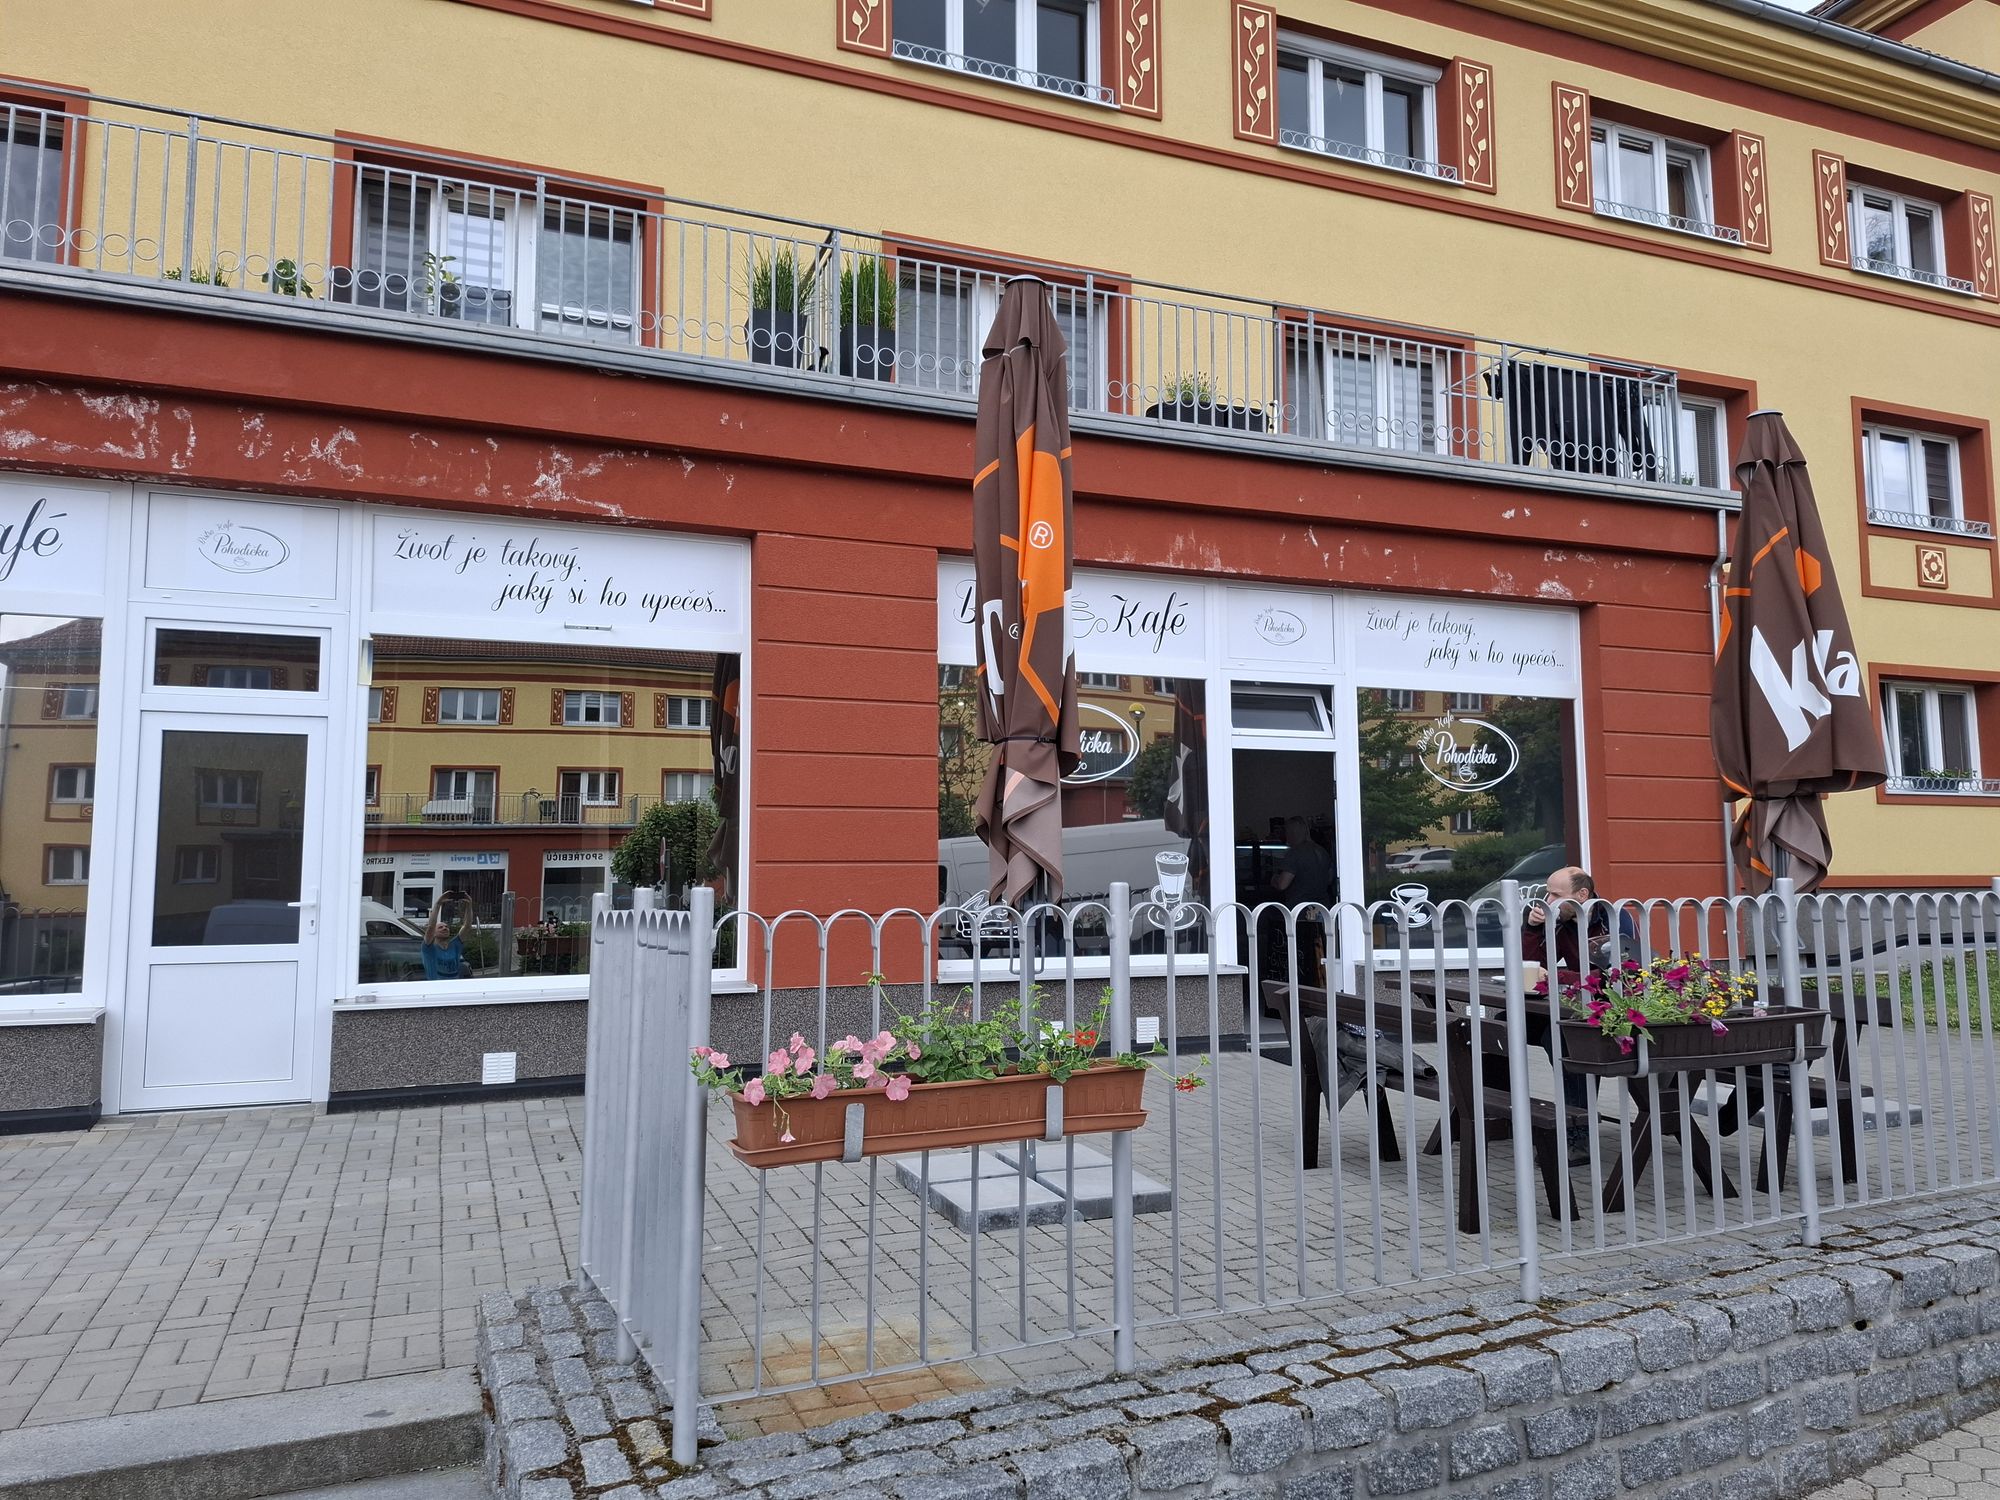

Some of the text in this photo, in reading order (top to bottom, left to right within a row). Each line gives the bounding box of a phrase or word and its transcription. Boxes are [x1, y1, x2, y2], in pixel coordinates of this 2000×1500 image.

[213, 532, 270, 557] Pohodička
[393, 527, 583, 582] Život je takový,
[490, 572, 727, 623] jaký si ho upečeš...
[1110, 591, 1189, 654] Kafé
[1365, 606, 1477, 646] Život je takový,
[1423, 638, 1462, 670] jaký
[1468, 642, 1481, 662] si
[1487, 640, 1504, 665] ho
[1416, 727, 1436, 752] Bistro
[1433, 730, 1498, 765] Pohodička
